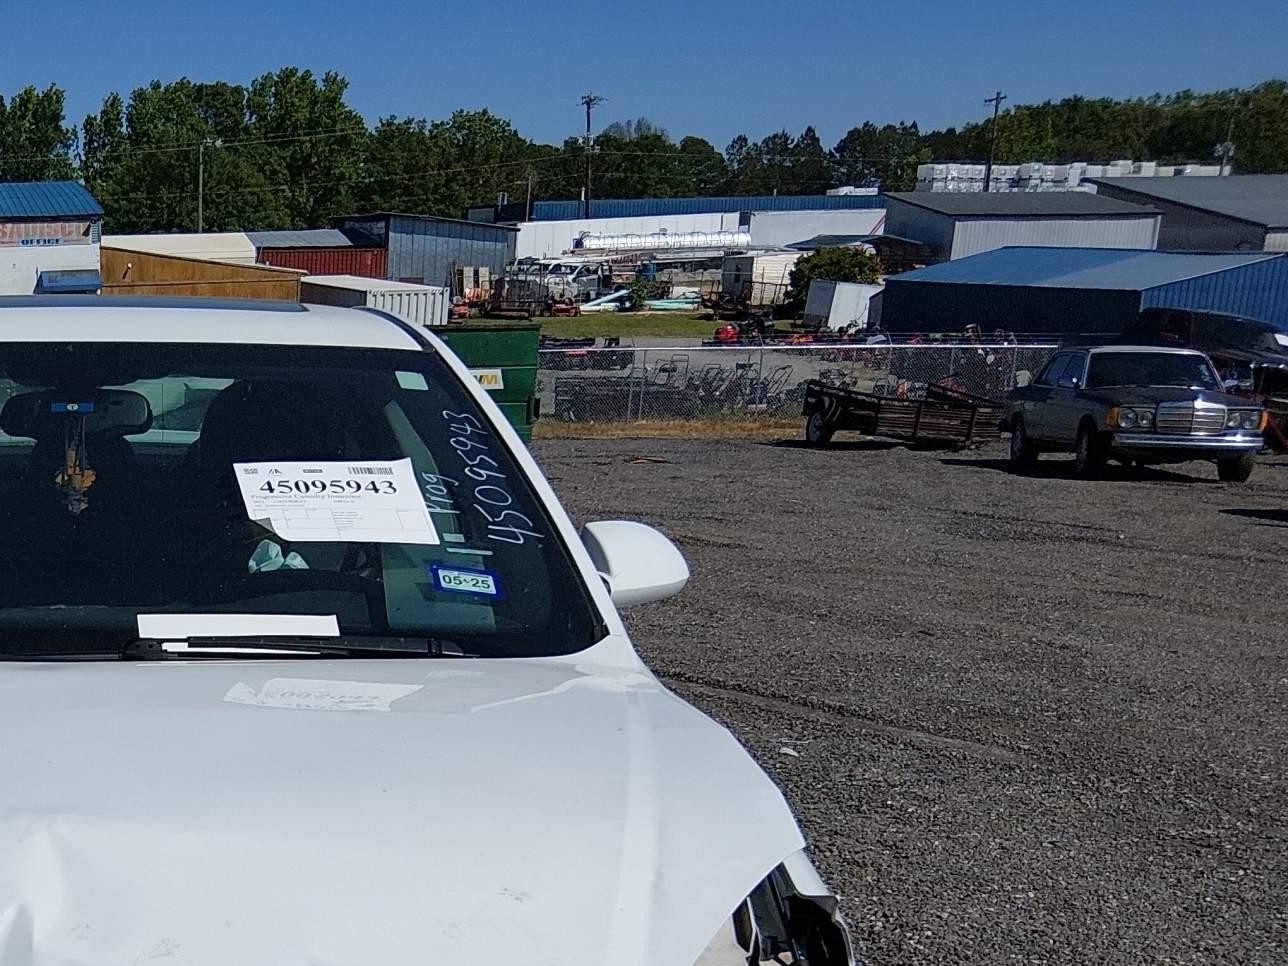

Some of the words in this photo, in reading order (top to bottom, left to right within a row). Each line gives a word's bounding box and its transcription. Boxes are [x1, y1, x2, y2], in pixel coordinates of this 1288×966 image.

[21, 238, 60, 246] OFFICE
[442, 410, 545, 545] 45095943
[259, 479, 398, 494] 45095943
